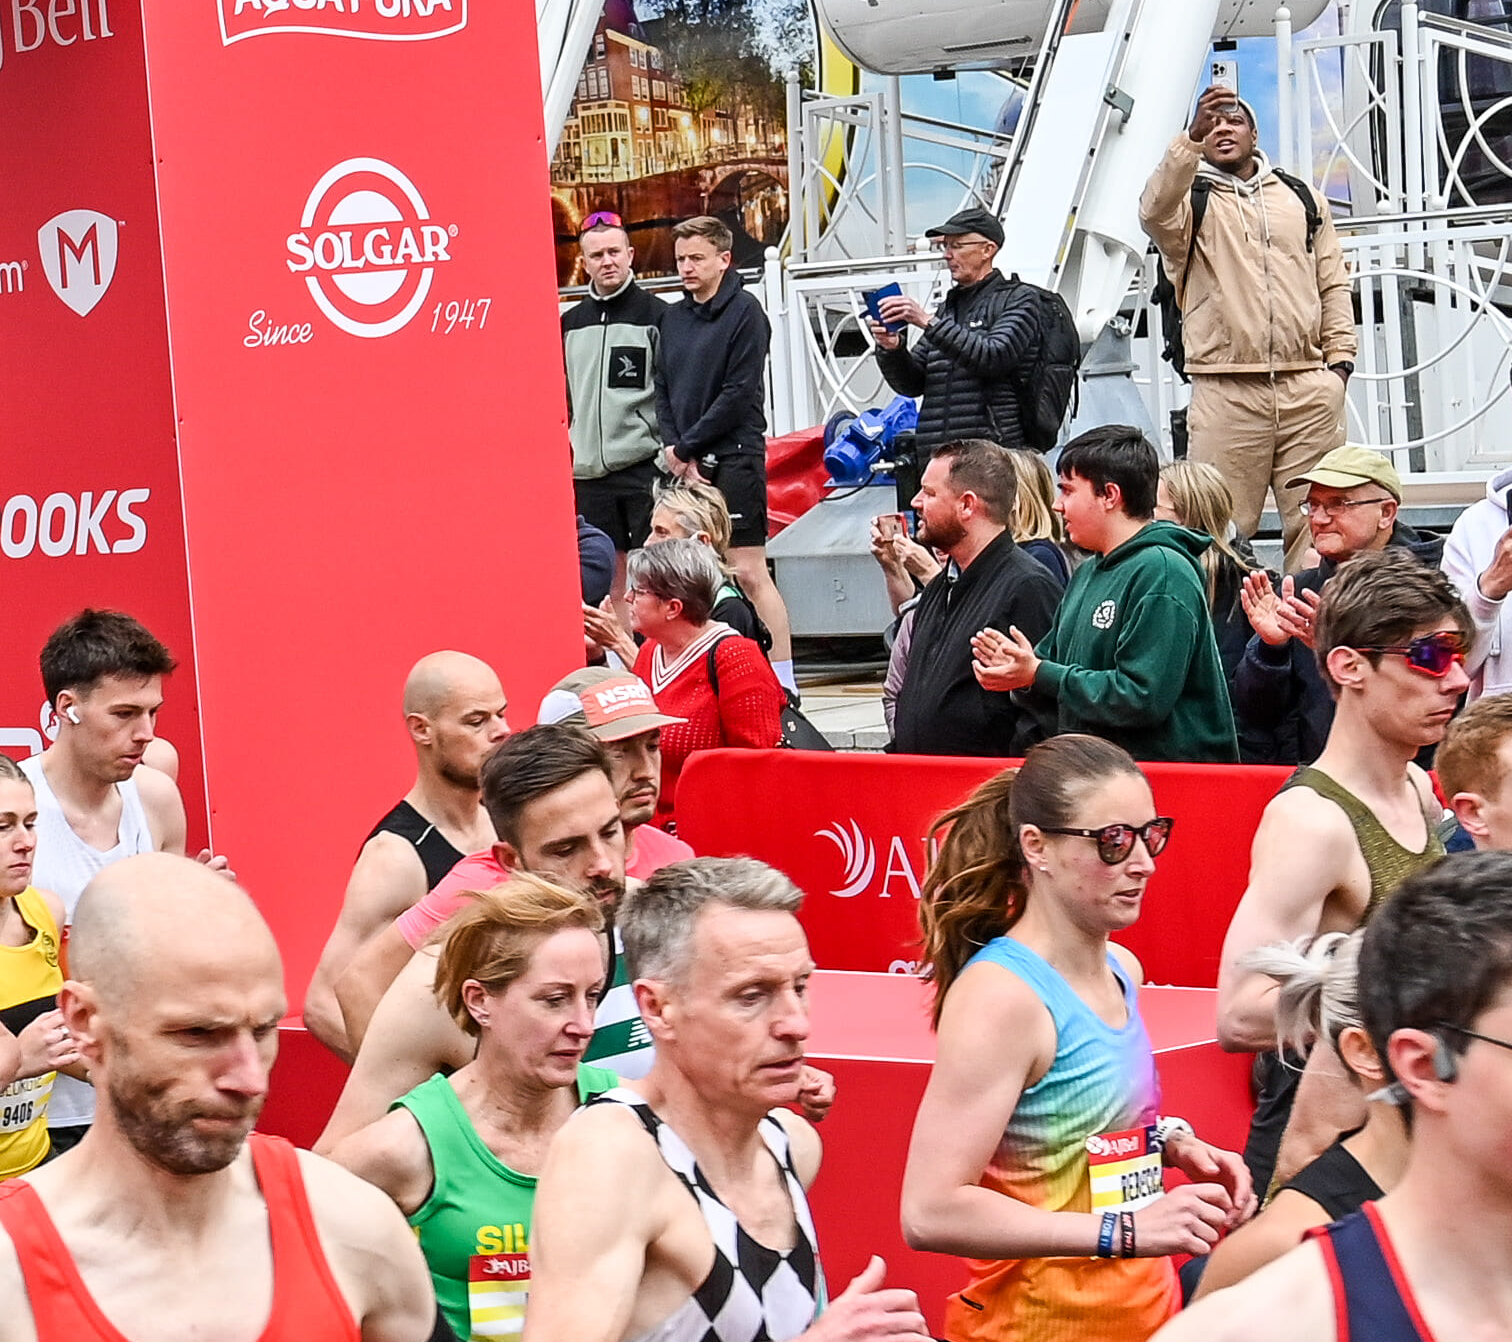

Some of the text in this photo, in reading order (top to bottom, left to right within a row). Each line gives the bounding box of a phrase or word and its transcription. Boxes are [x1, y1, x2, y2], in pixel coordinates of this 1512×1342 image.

[286, 227, 451, 272] SOLGAR
[244, 298, 492, 347] Since 1947
[2, 1100, 34, 1127] 9406
[476, 1223, 529, 1256] SIL
